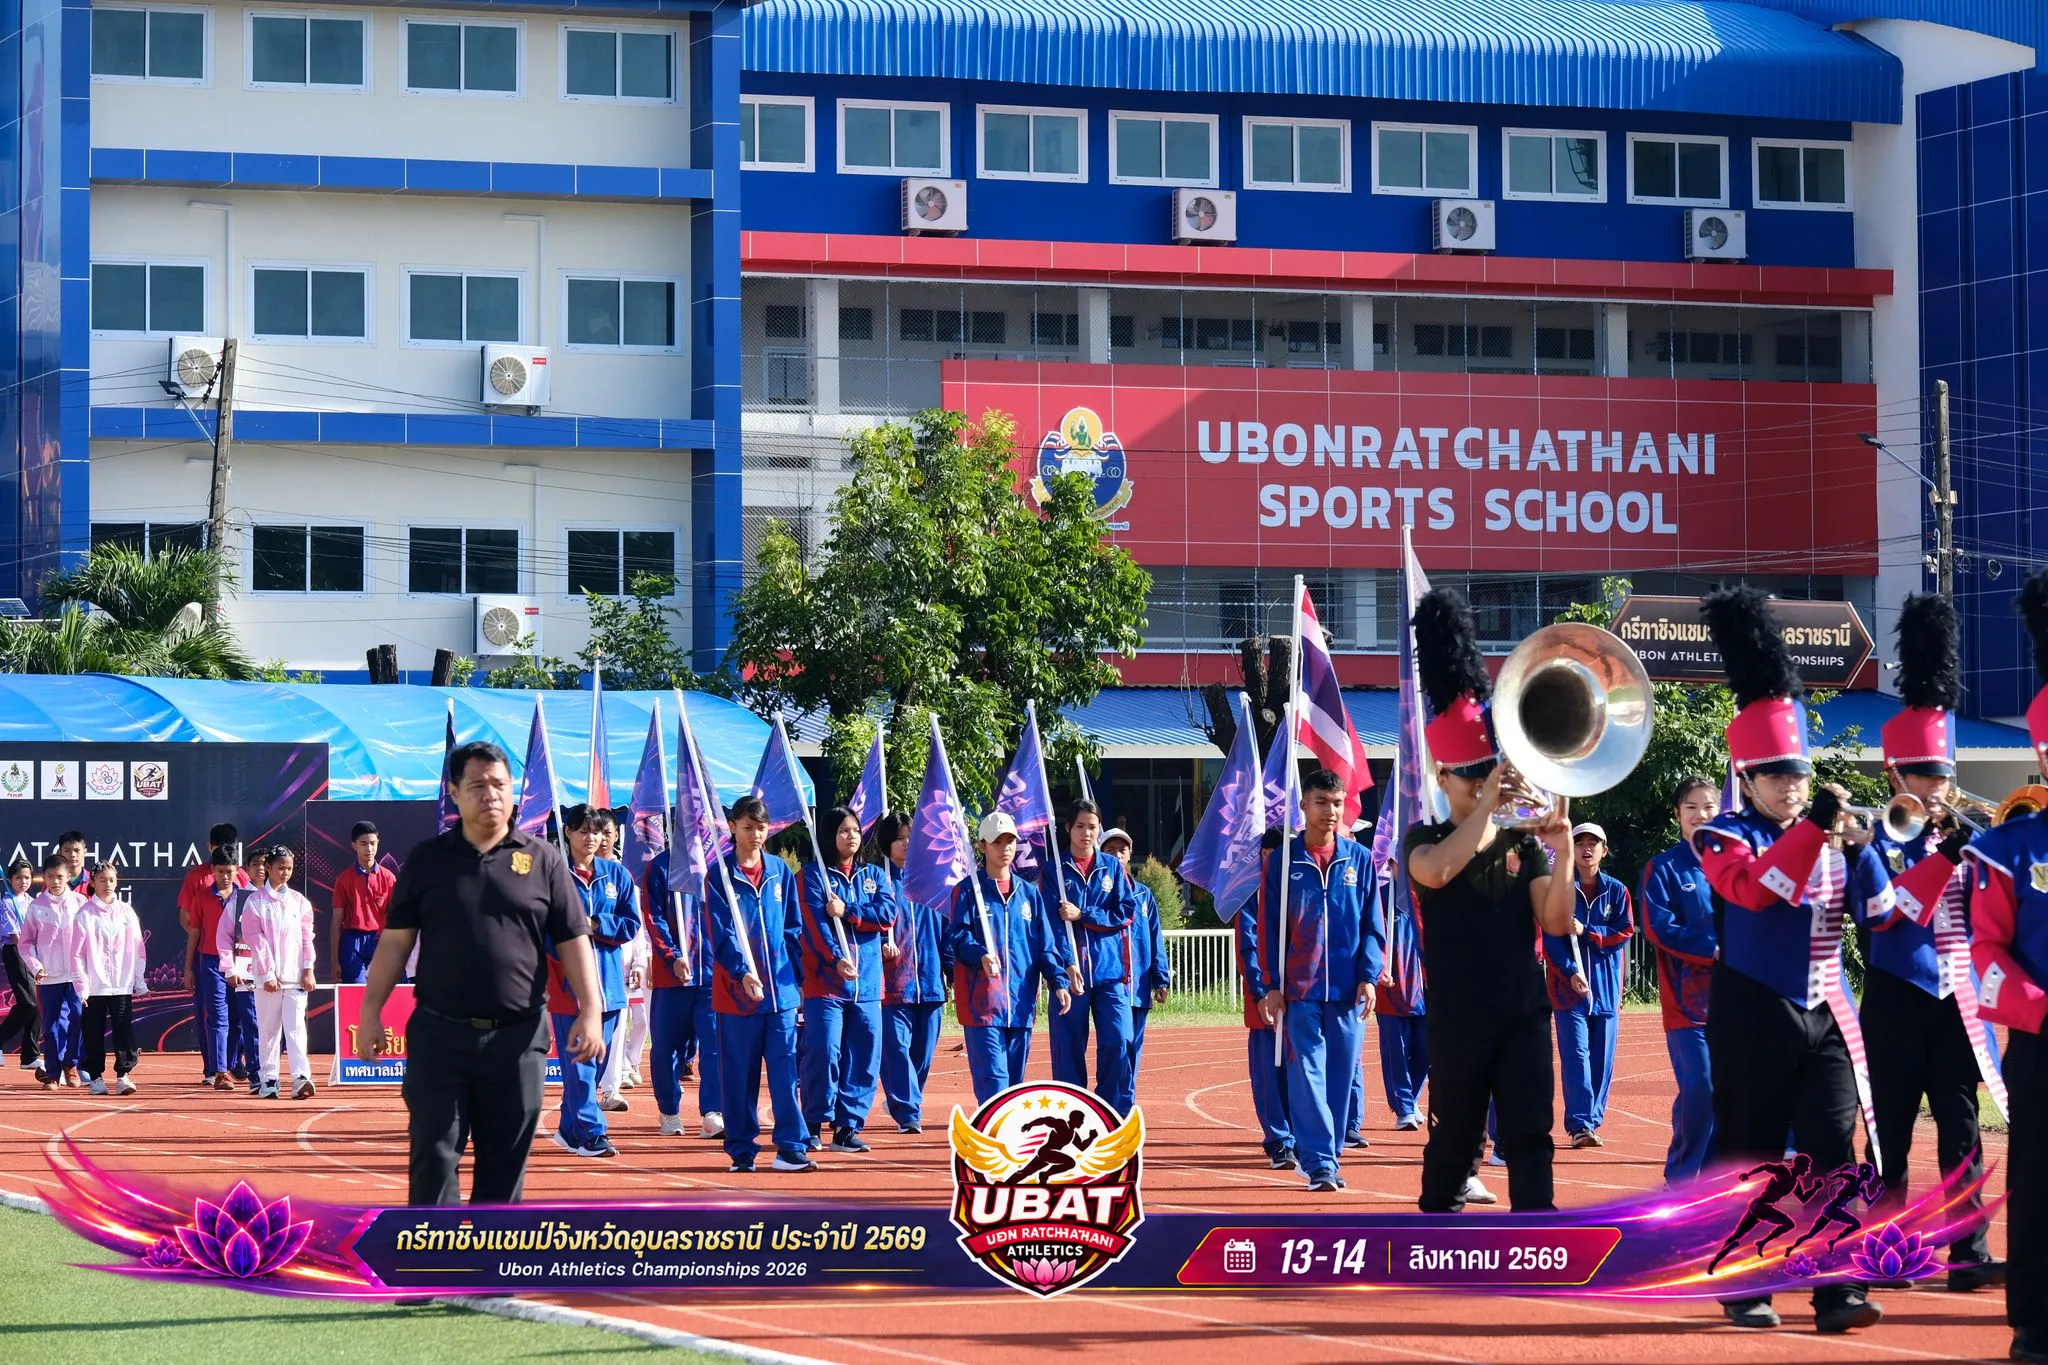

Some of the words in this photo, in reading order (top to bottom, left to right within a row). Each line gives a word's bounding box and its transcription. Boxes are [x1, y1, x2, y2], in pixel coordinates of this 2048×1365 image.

[1197, 420, 1716, 476] UBONRATCHATHANI
[1259, 484, 1456, 532] SPORTS
[1485, 488, 1678, 536] SCHOOL
[1671, 651, 1723, 663] ATHLETI
[1791, 655, 1845, 667] ONSHIPS
[136, 780, 163, 788] UBAT
